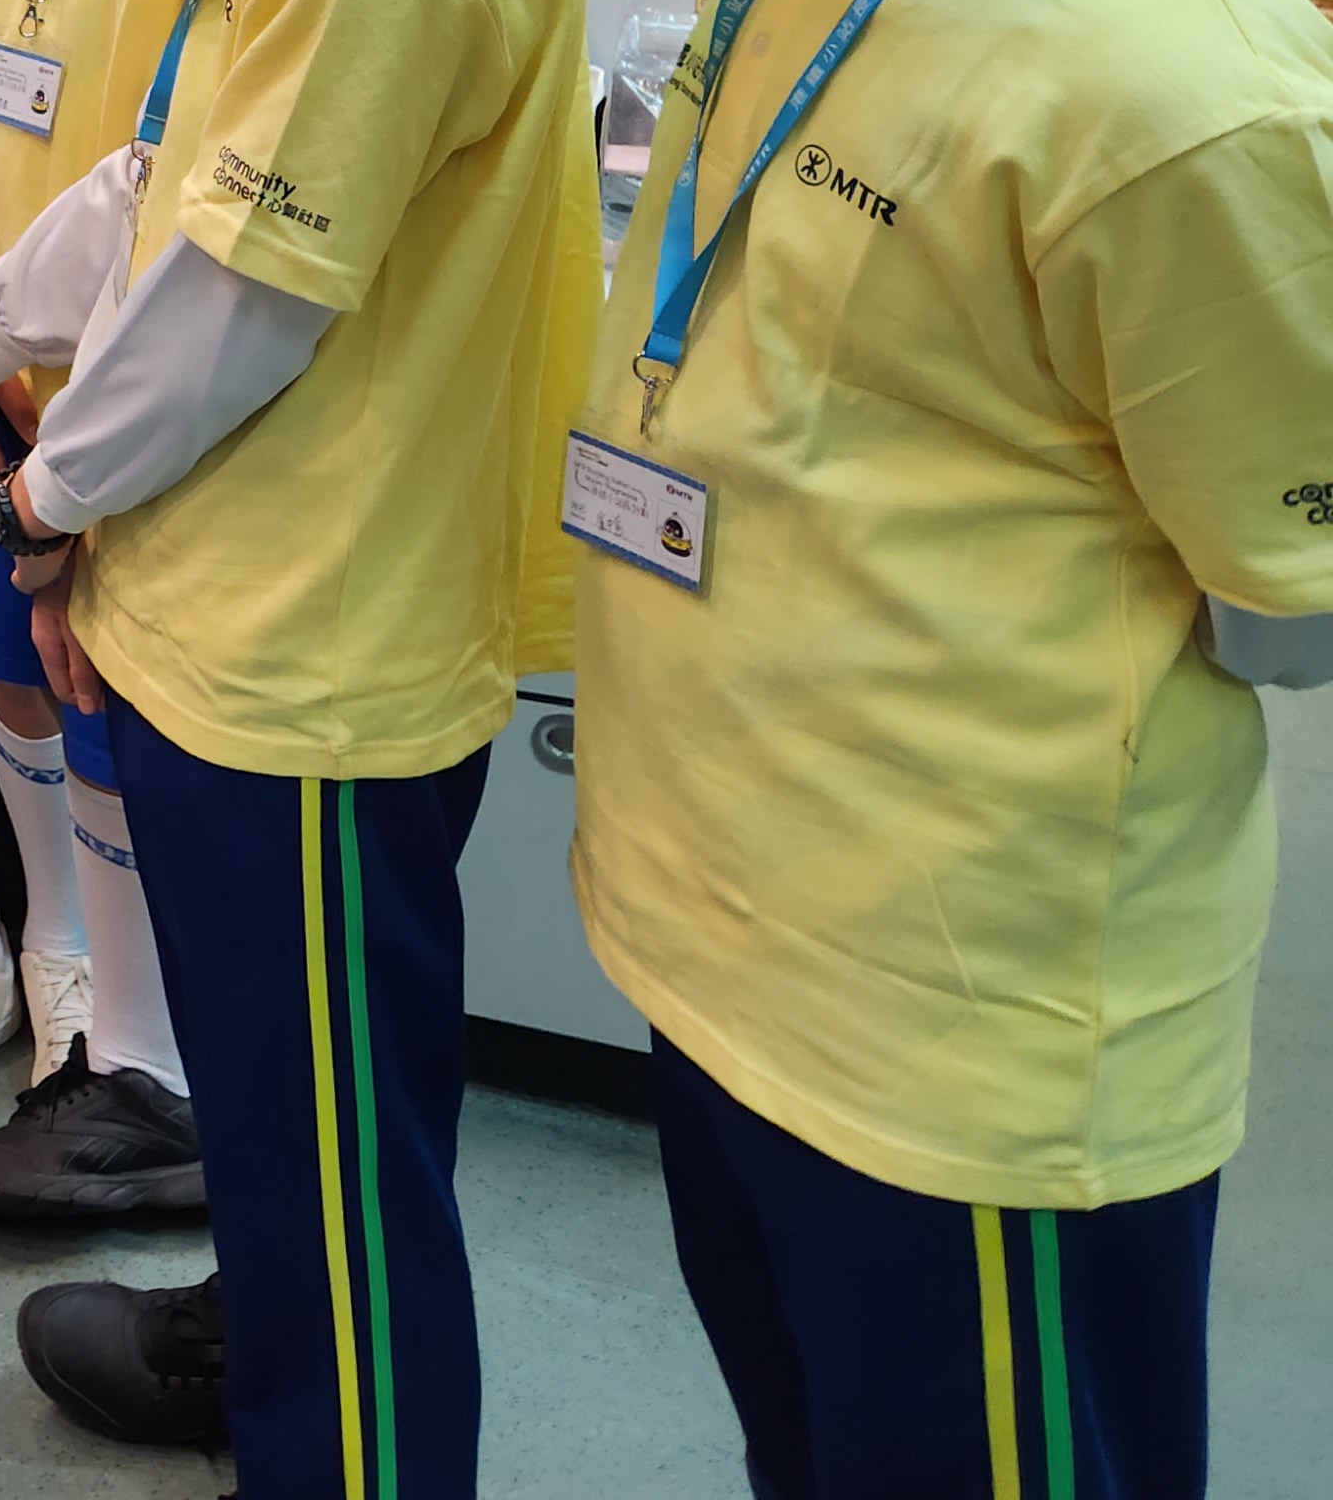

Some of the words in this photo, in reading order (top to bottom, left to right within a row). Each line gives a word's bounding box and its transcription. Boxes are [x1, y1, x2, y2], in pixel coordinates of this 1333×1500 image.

[213, 166, 266, 207] connect
[218, 145, 297, 201] community
[828, 169, 899, 228] MTR
